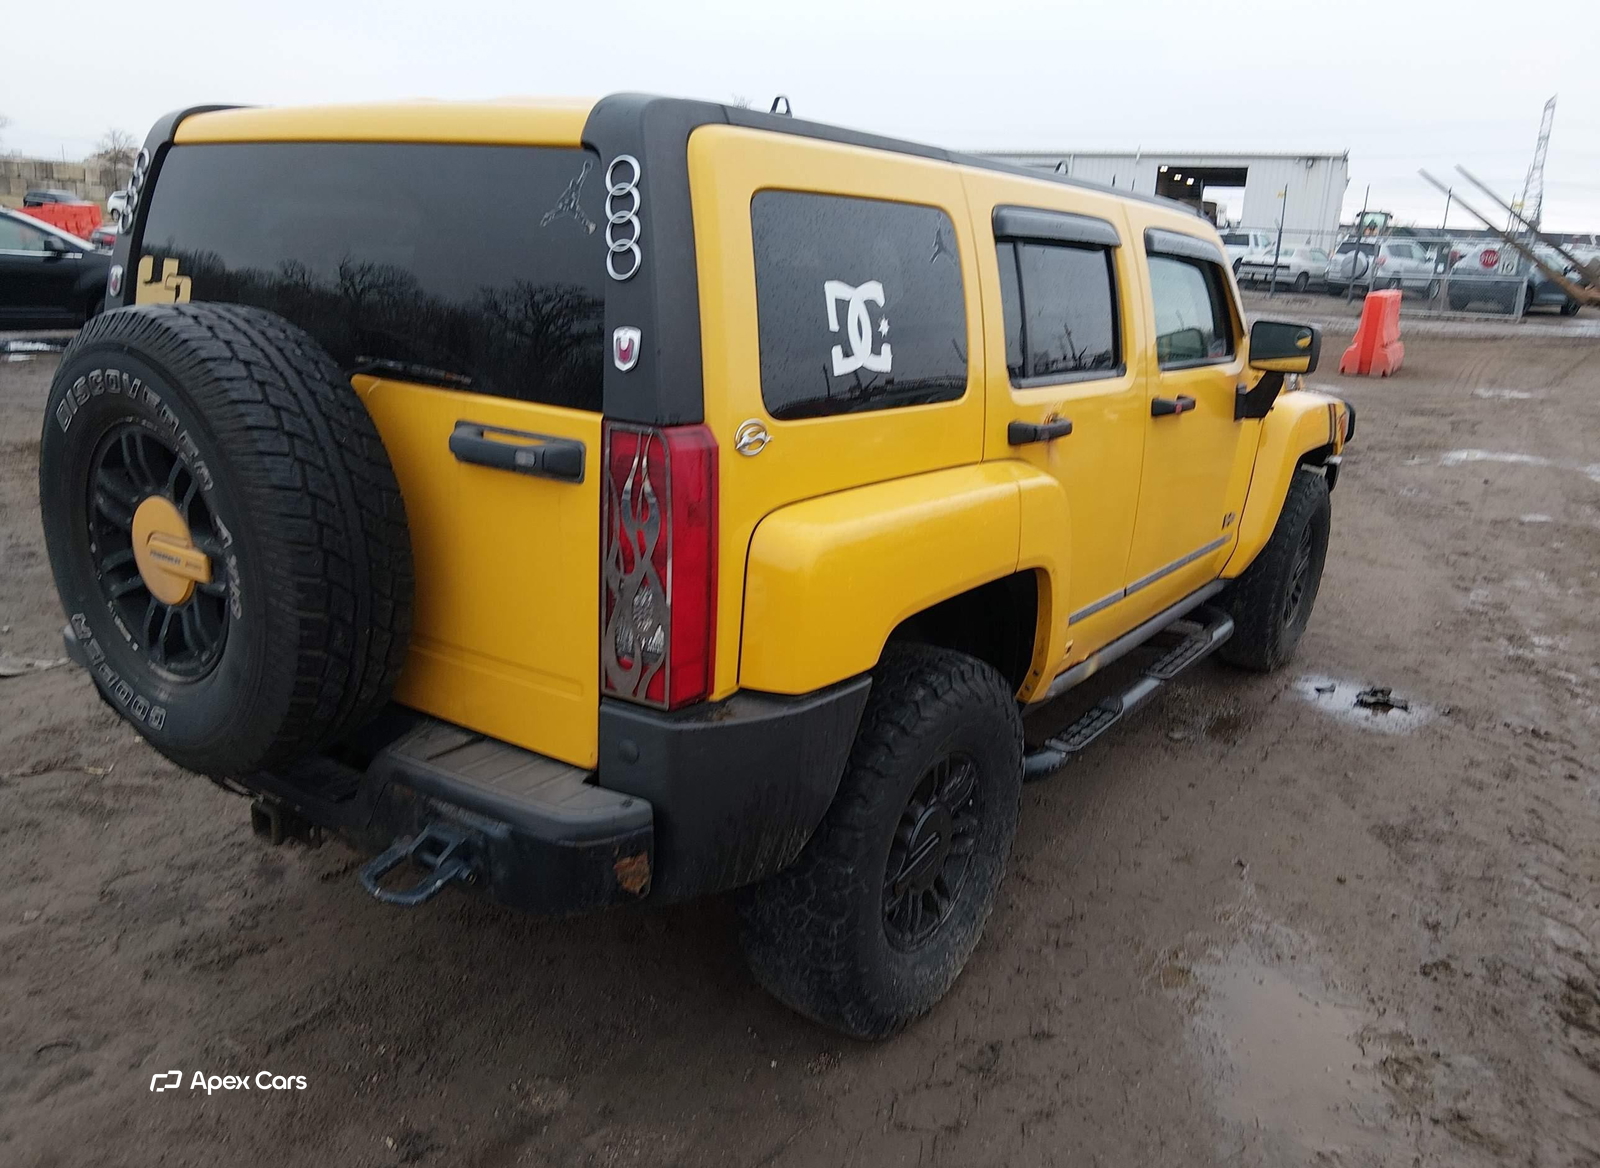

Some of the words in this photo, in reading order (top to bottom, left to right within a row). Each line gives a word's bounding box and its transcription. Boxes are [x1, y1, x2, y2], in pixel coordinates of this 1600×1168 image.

[1501, 261, 1515, 274] 10
[56, 369, 214, 491] DISCOVERER
[71, 613, 167, 731] COOPER
